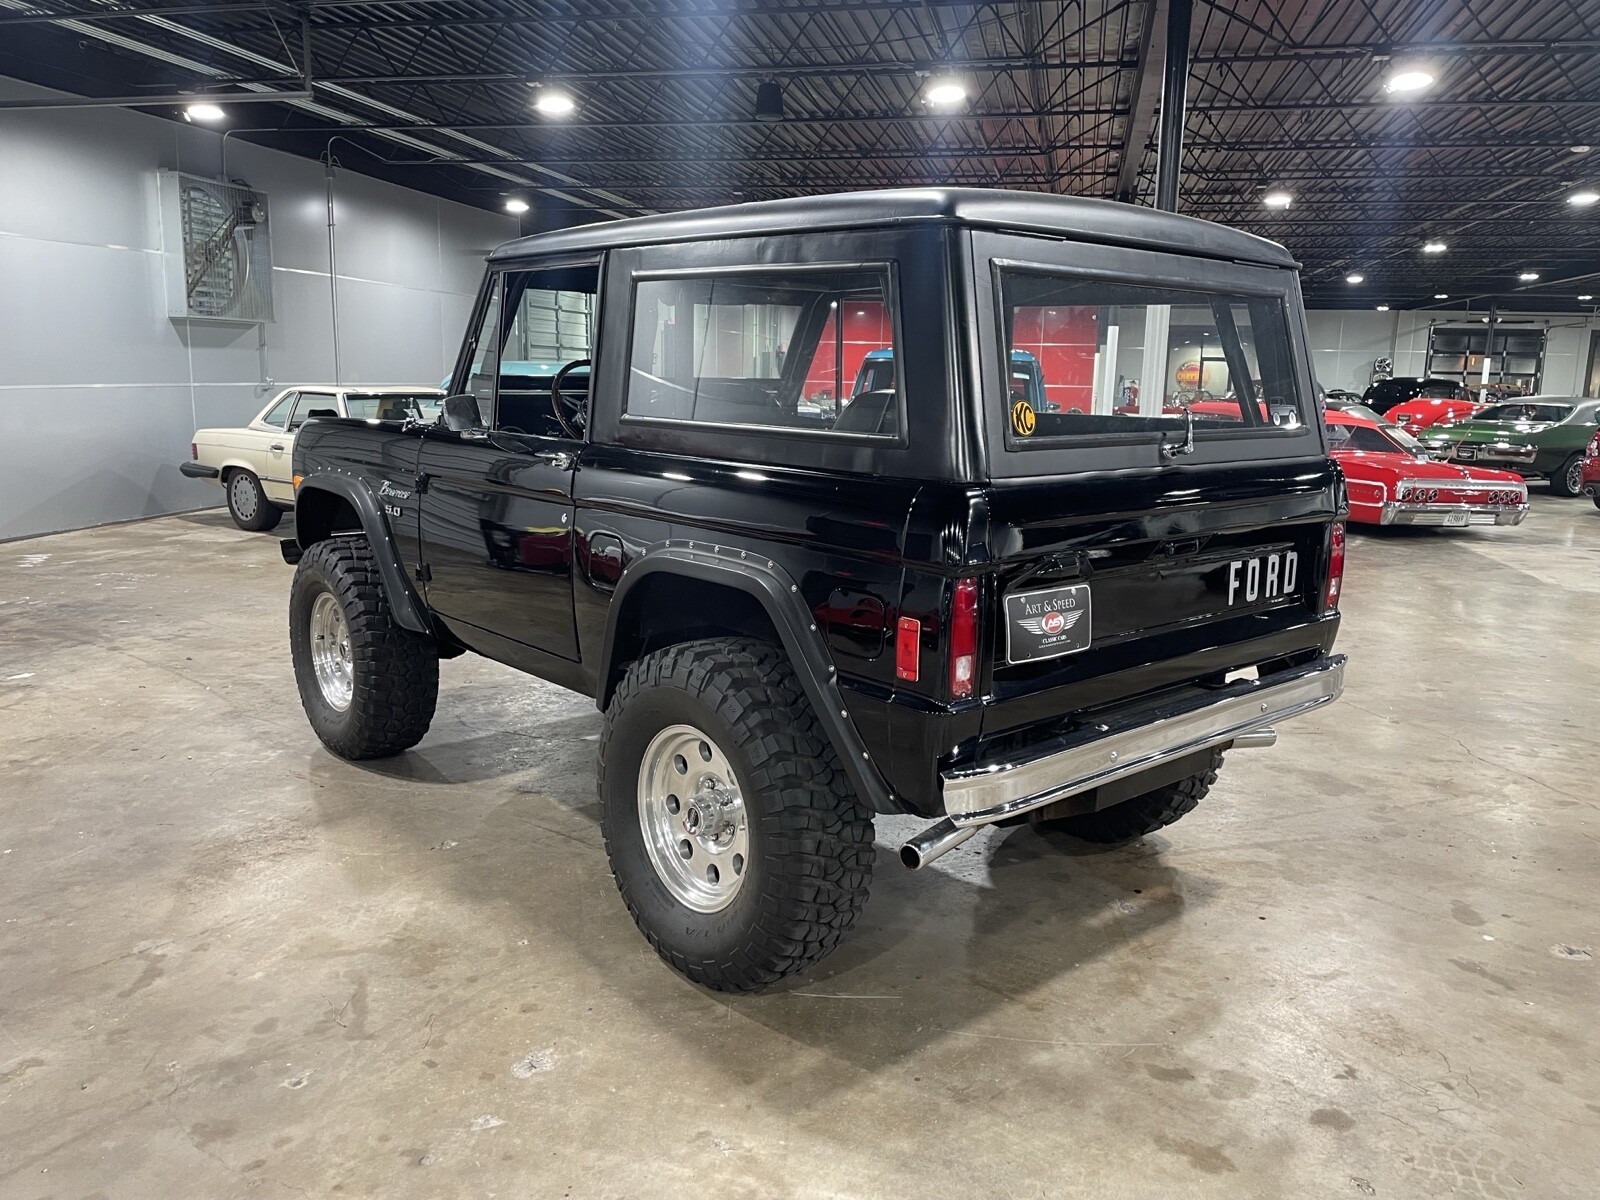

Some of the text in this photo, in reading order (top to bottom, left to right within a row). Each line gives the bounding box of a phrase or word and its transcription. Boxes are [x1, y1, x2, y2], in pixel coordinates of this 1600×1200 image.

[1015, 402, 1034, 434] KC
[385, 505, 401, 517] 5.0
[1228, 551, 1298, 606] FORD
[1025, 598, 1076, 615] ART & SPEED
